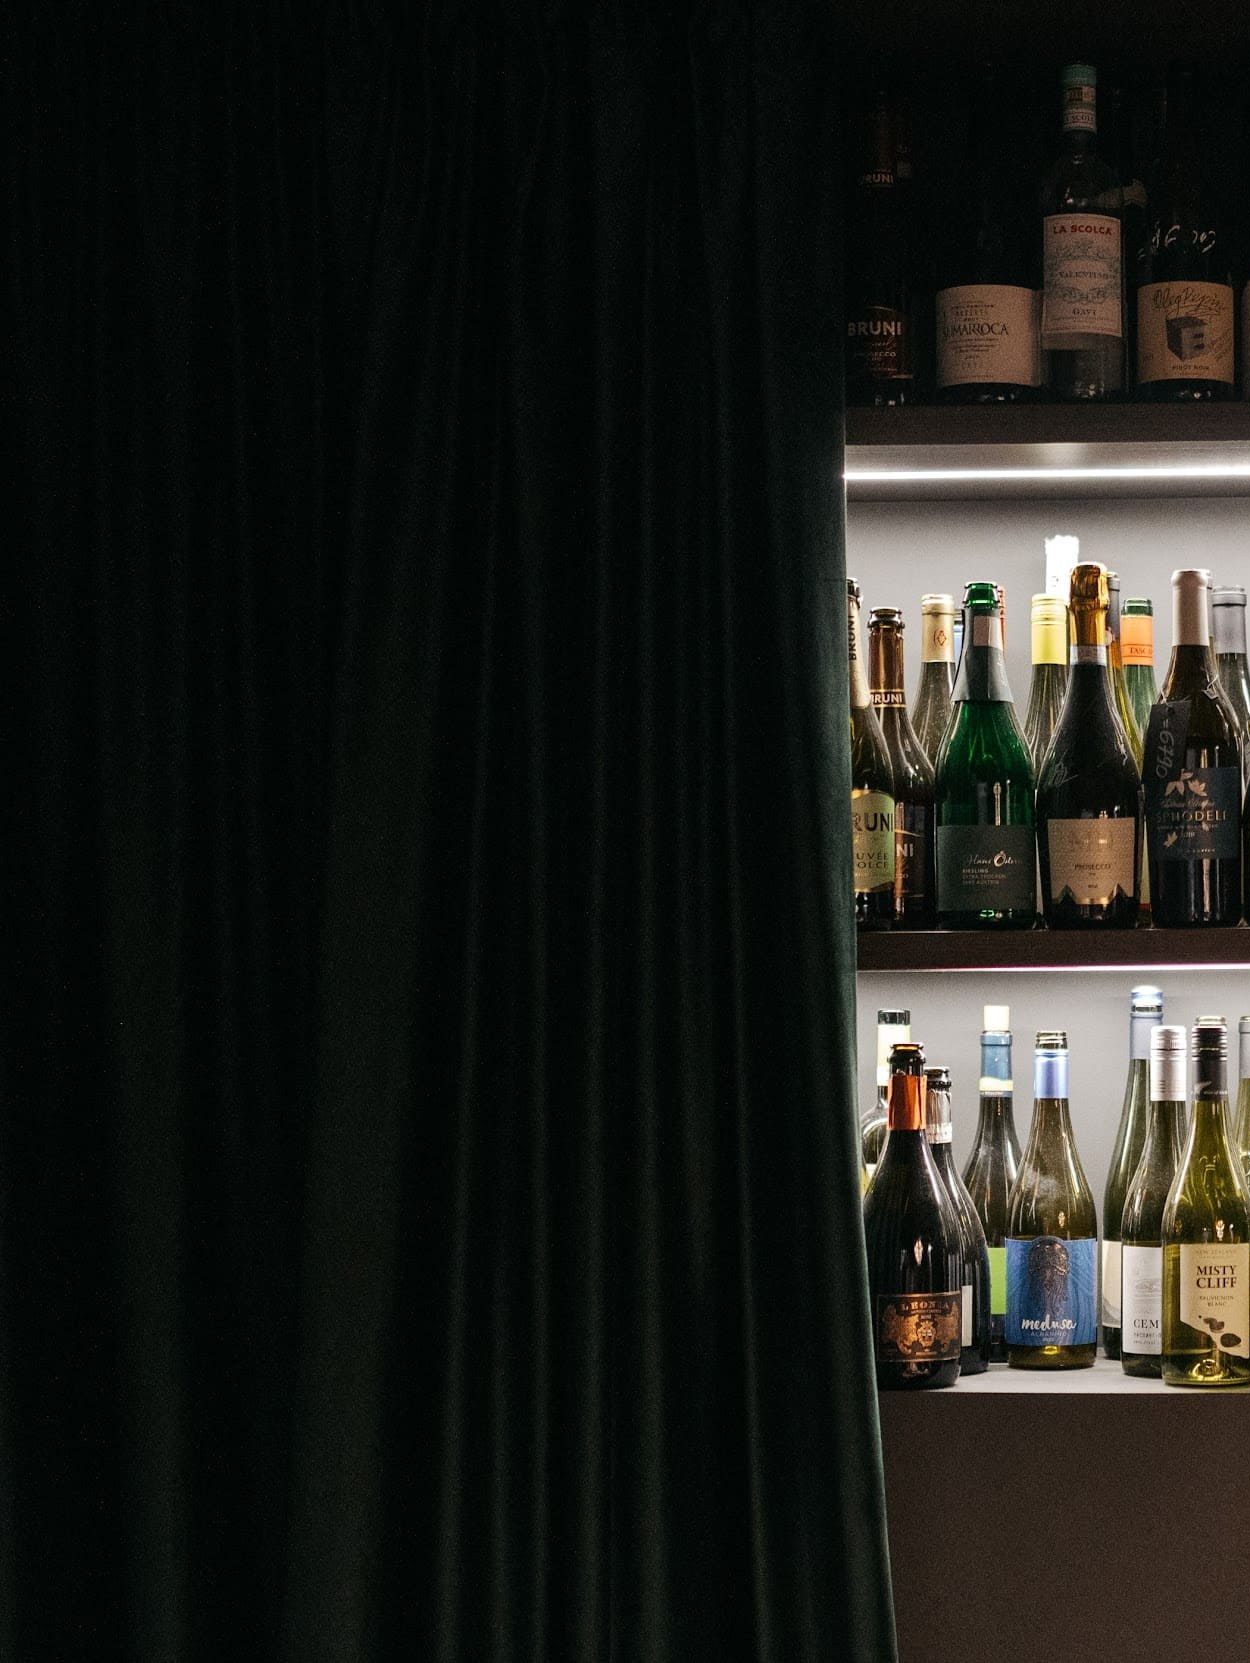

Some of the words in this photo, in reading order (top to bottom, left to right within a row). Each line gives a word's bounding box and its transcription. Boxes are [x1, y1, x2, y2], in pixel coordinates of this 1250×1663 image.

[862, 172, 896, 184] RUNI
[1053, 226, 1067, 236] LA
[1070, 225, 1112, 236] SCOLCA
[848, 321, 903, 337] BRUNI
[853, 812, 894, 832] RUNI
[856, 852, 888, 860] UVÉE
[857, 861, 888, 869] OLCE
[1197, 1265, 1237, 1276] MISTY
[1196, 1277, 1237, 1289] CLIFF
[1021, 1314, 1077, 1331] medusa
